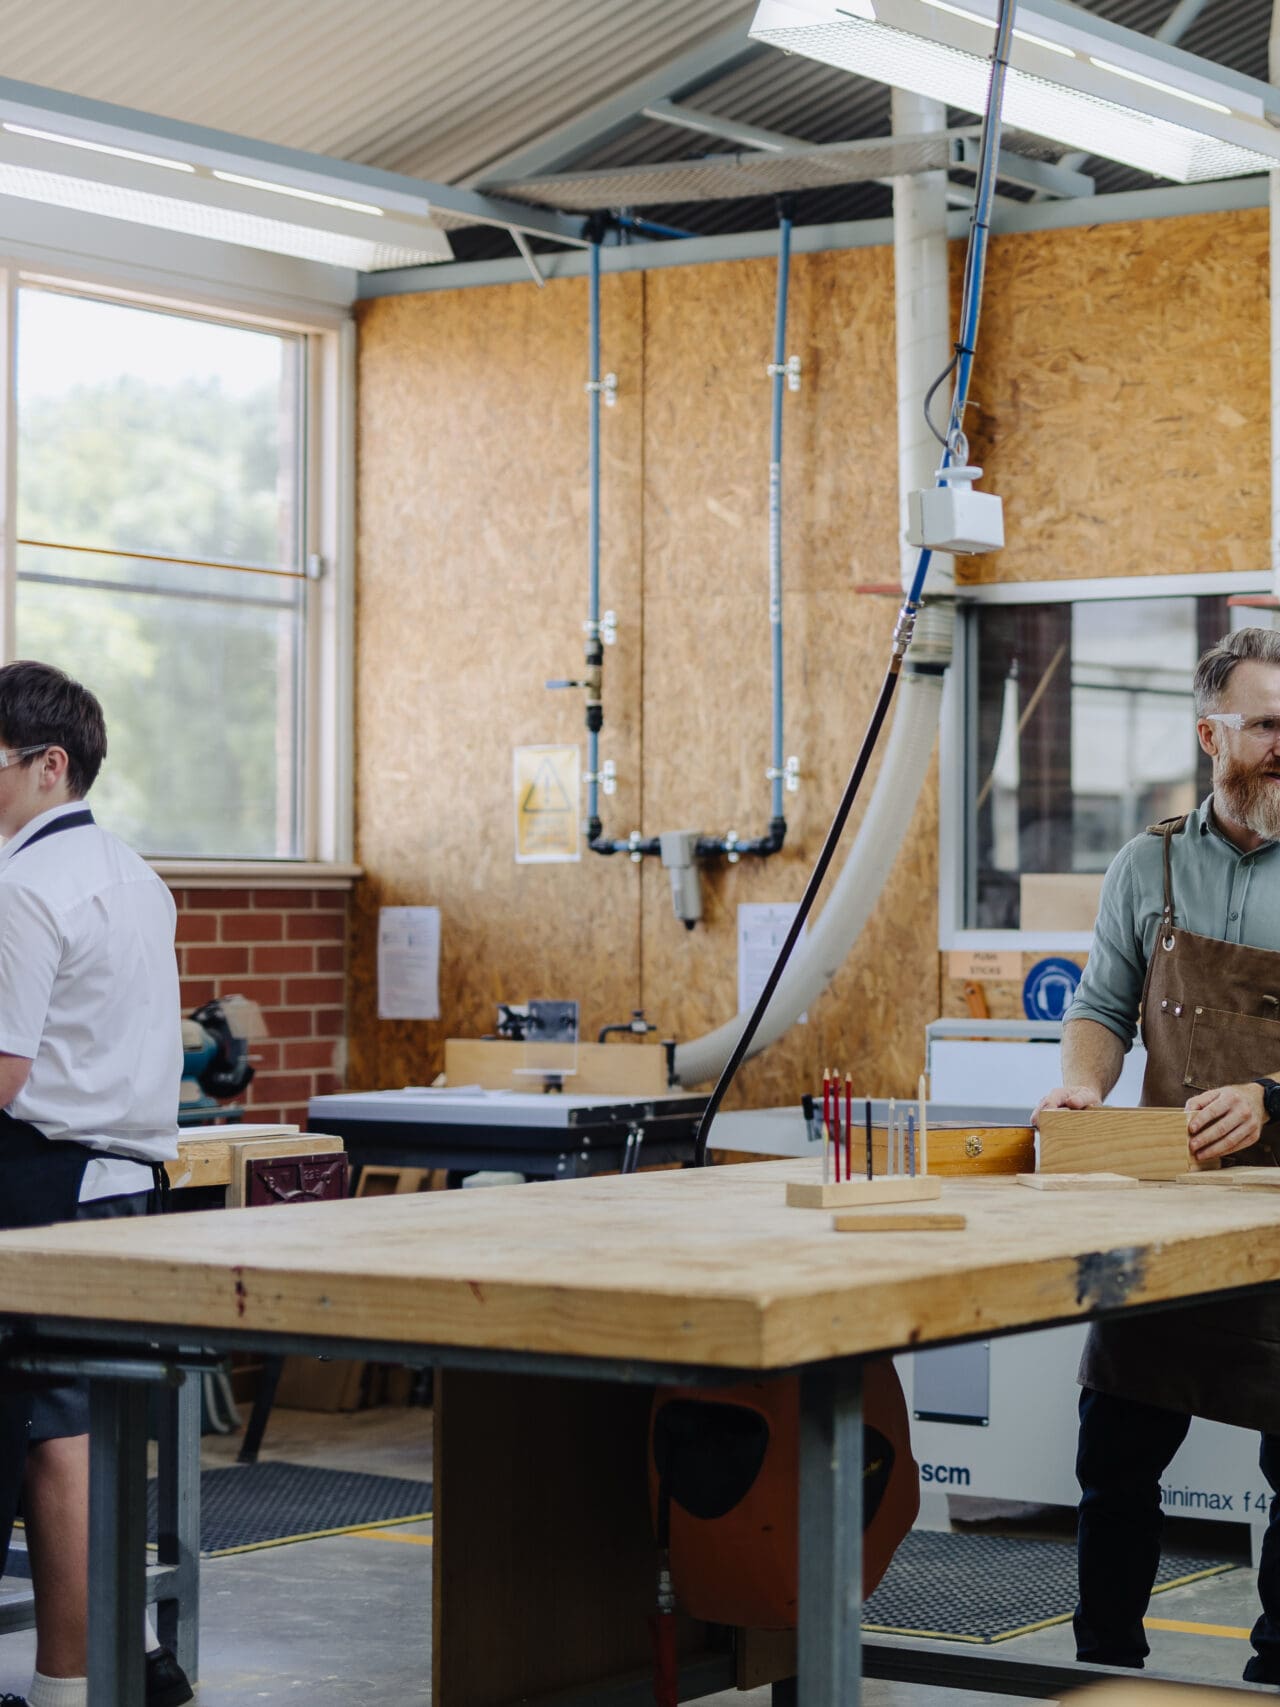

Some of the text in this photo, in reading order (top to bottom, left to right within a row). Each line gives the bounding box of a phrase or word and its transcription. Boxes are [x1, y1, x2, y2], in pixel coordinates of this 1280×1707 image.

[970, 965, 1002, 975] STICKS
[921, 1463, 971, 1486] scm
[1244, 1491, 1251, 1513] f
